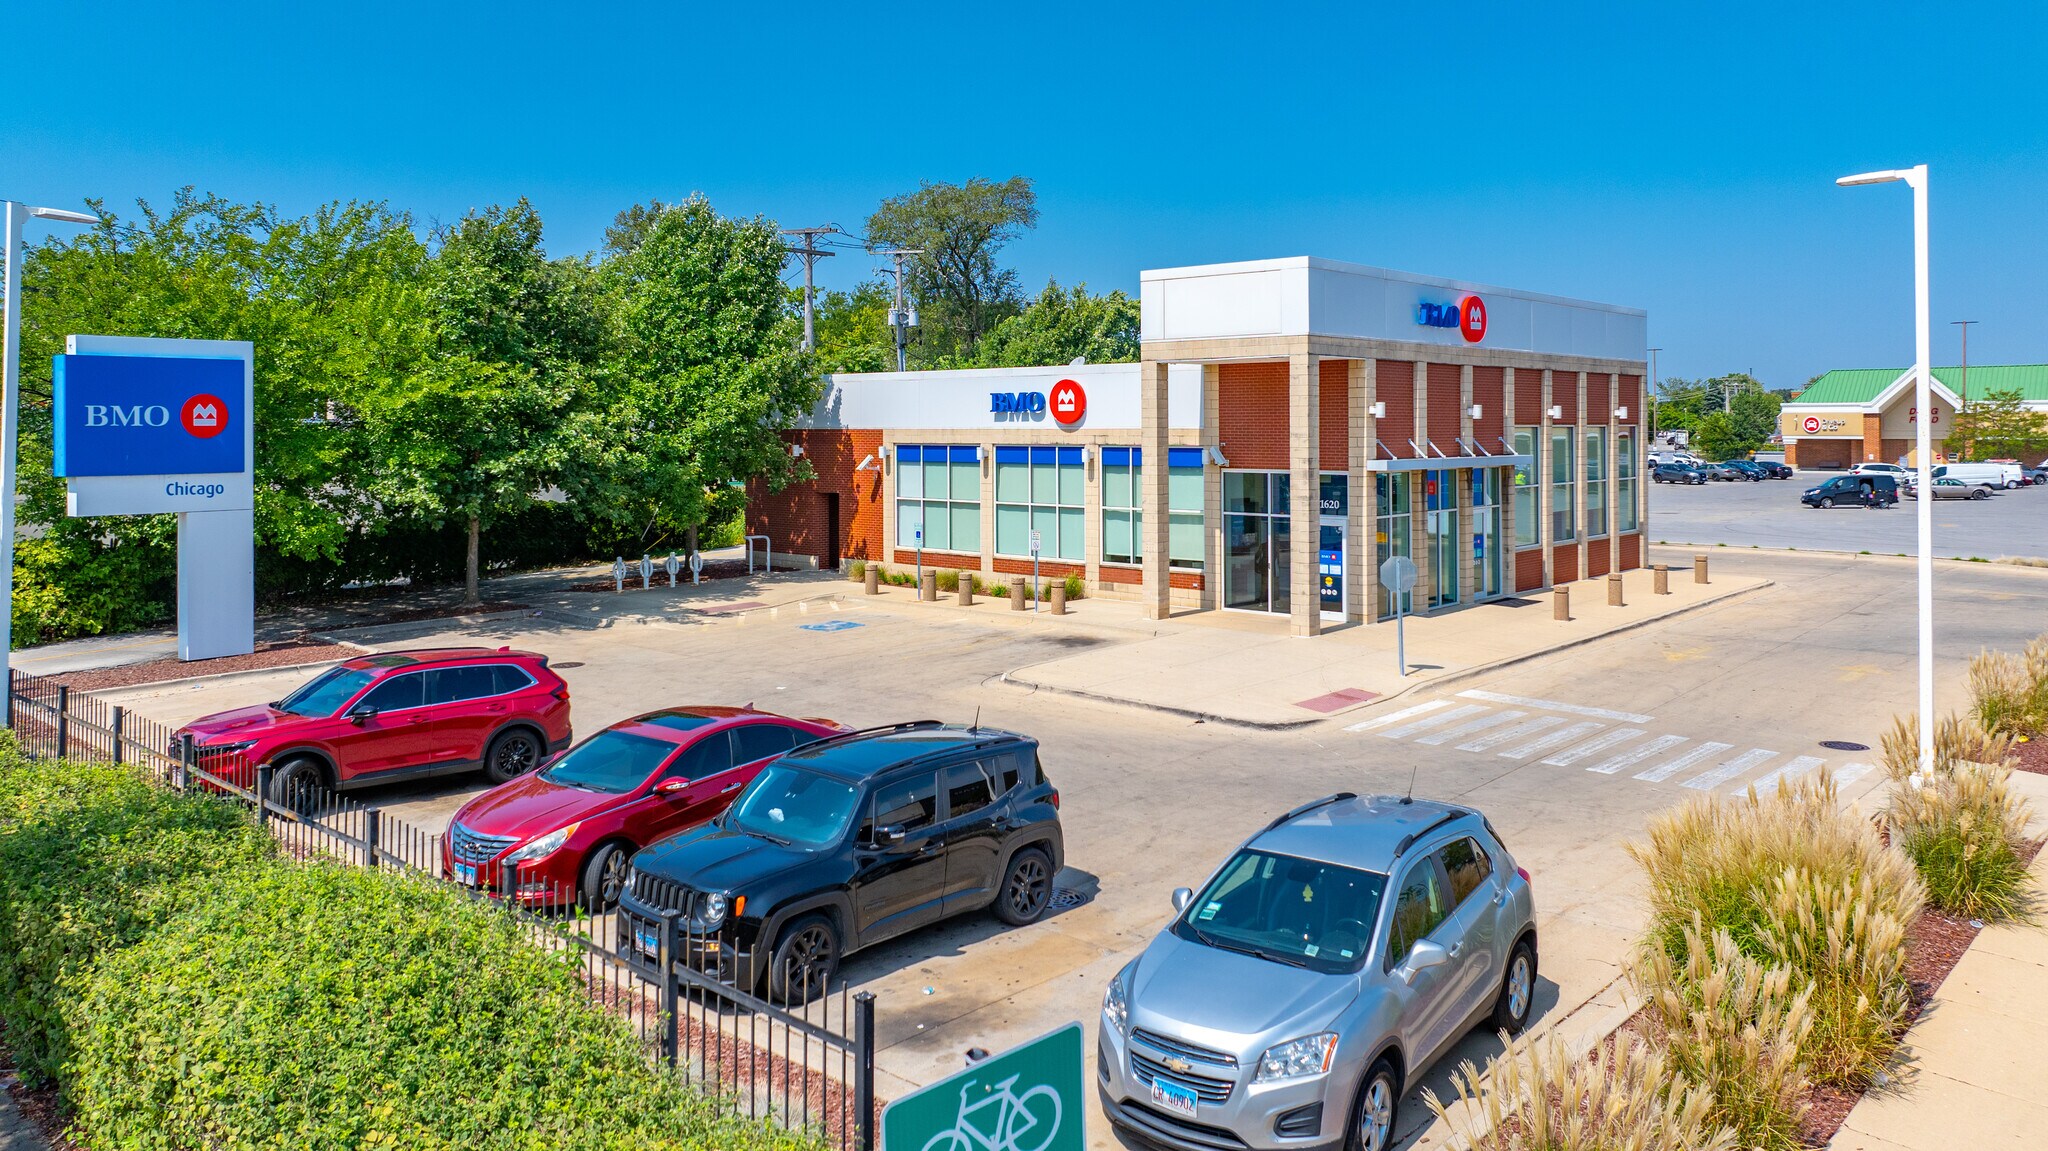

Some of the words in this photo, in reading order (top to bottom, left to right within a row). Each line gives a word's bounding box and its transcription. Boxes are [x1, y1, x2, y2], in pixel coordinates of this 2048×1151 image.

[989, 391, 1046, 413] BMO
[84, 404, 170, 427] BMO
[1908, 407, 1939, 415] DG
[1908, 416, 1939, 424] FD
[165, 481, 225, 498] Chicago
[1319, 499, 1340, 510] 1620
